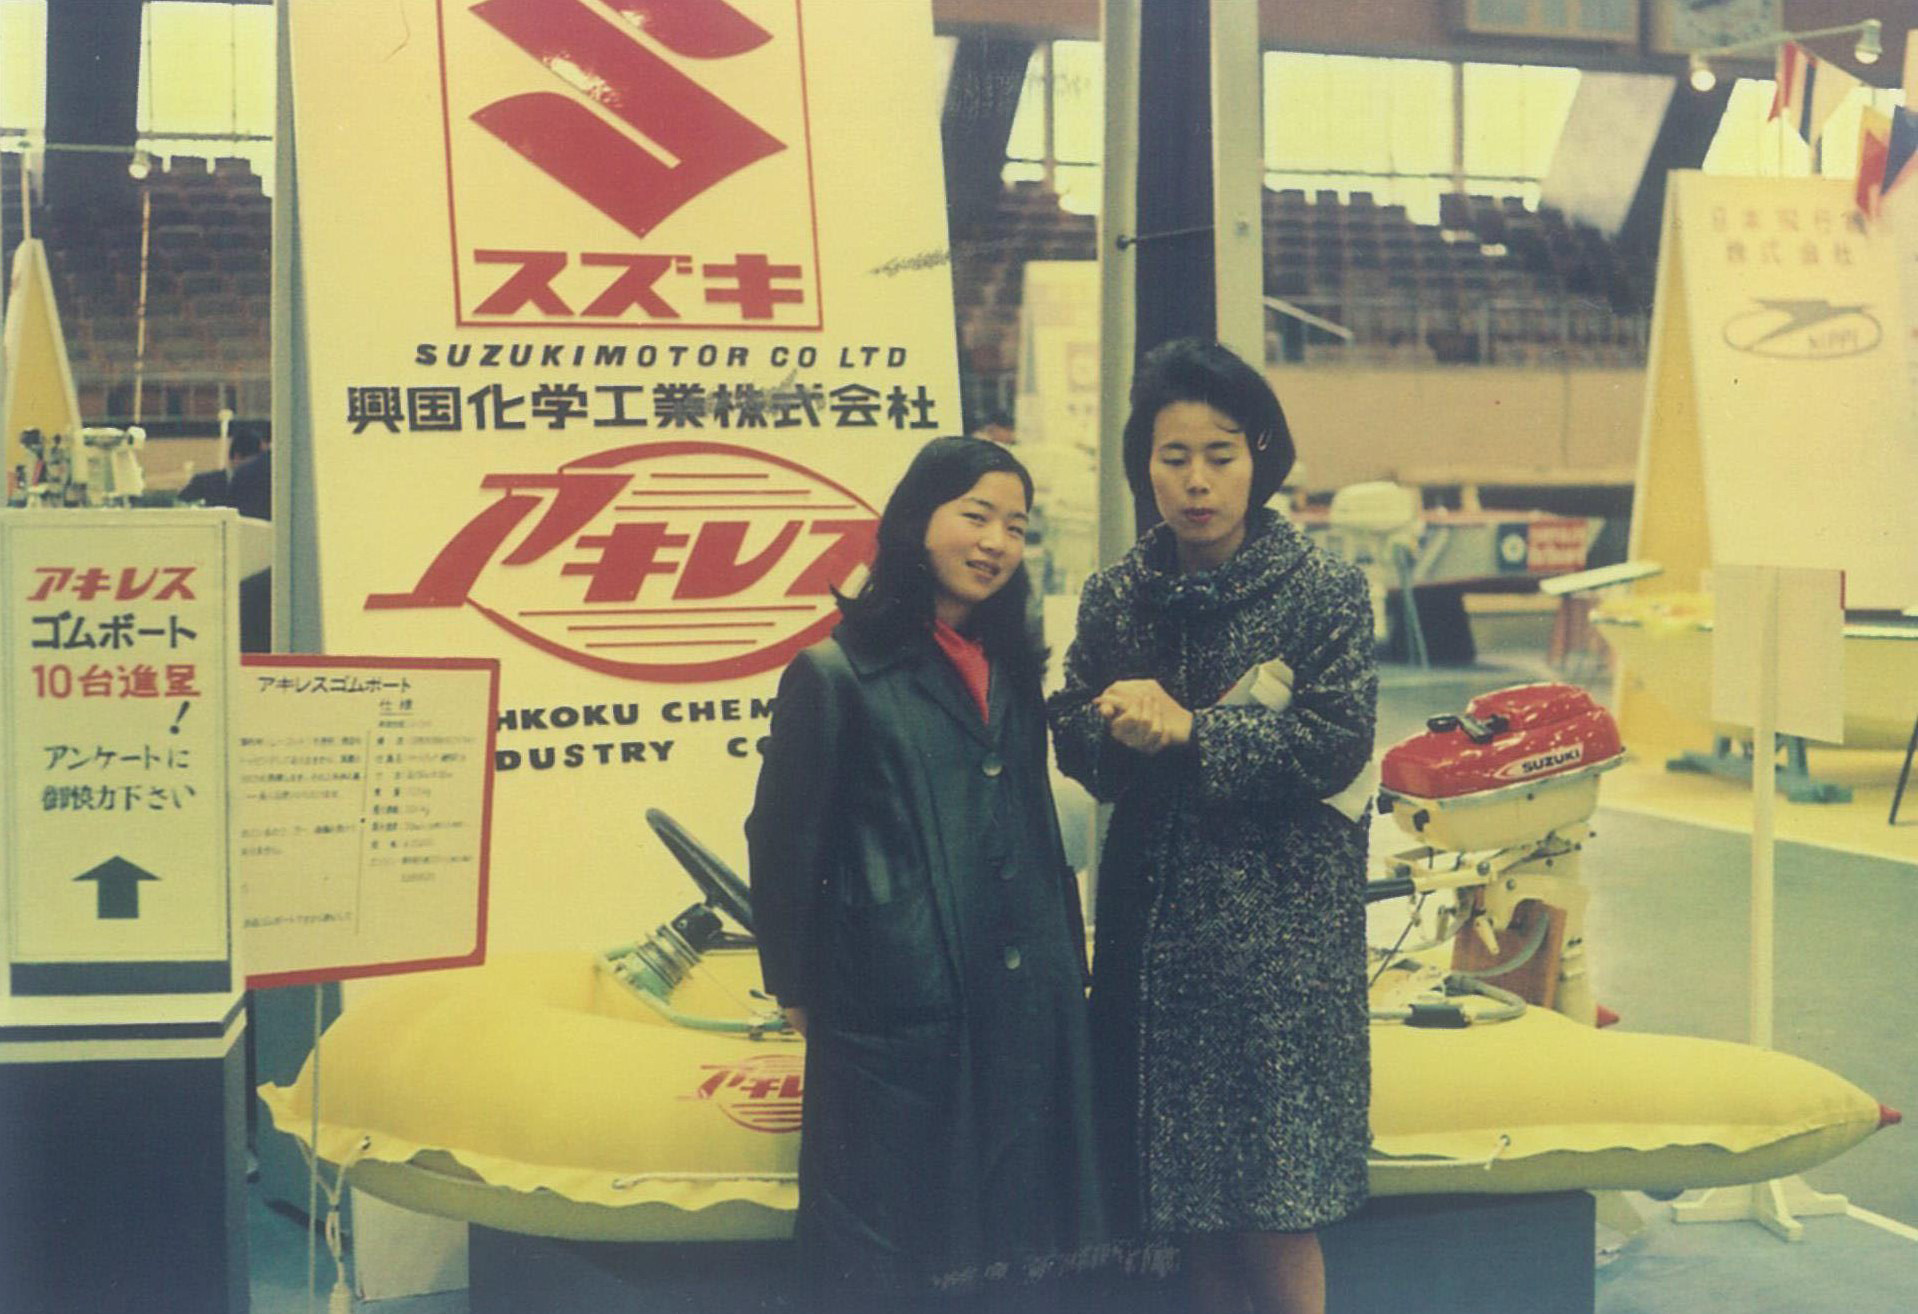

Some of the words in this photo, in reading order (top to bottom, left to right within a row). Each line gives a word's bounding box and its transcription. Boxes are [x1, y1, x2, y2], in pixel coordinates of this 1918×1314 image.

[472, 249, 804, 320] スズキ
[770, 345, 818, 368] CO
[839, 346, 909, 368] LTD
[346, 383, 940, 434] 興国化学工業株式会社
[26, 566, 197, 601] アキレス
[32, 610, 197, 649] ゴムボート
[31, 664, 201, 698] 10台進呈
[257, 676, 411, 693] アキレスゴムボート
[43, 744, 190, 770] アンケートに
[495, 740, 675, 771] DUSTRY
[1521, 750, 1581, 772] SUZUKI
